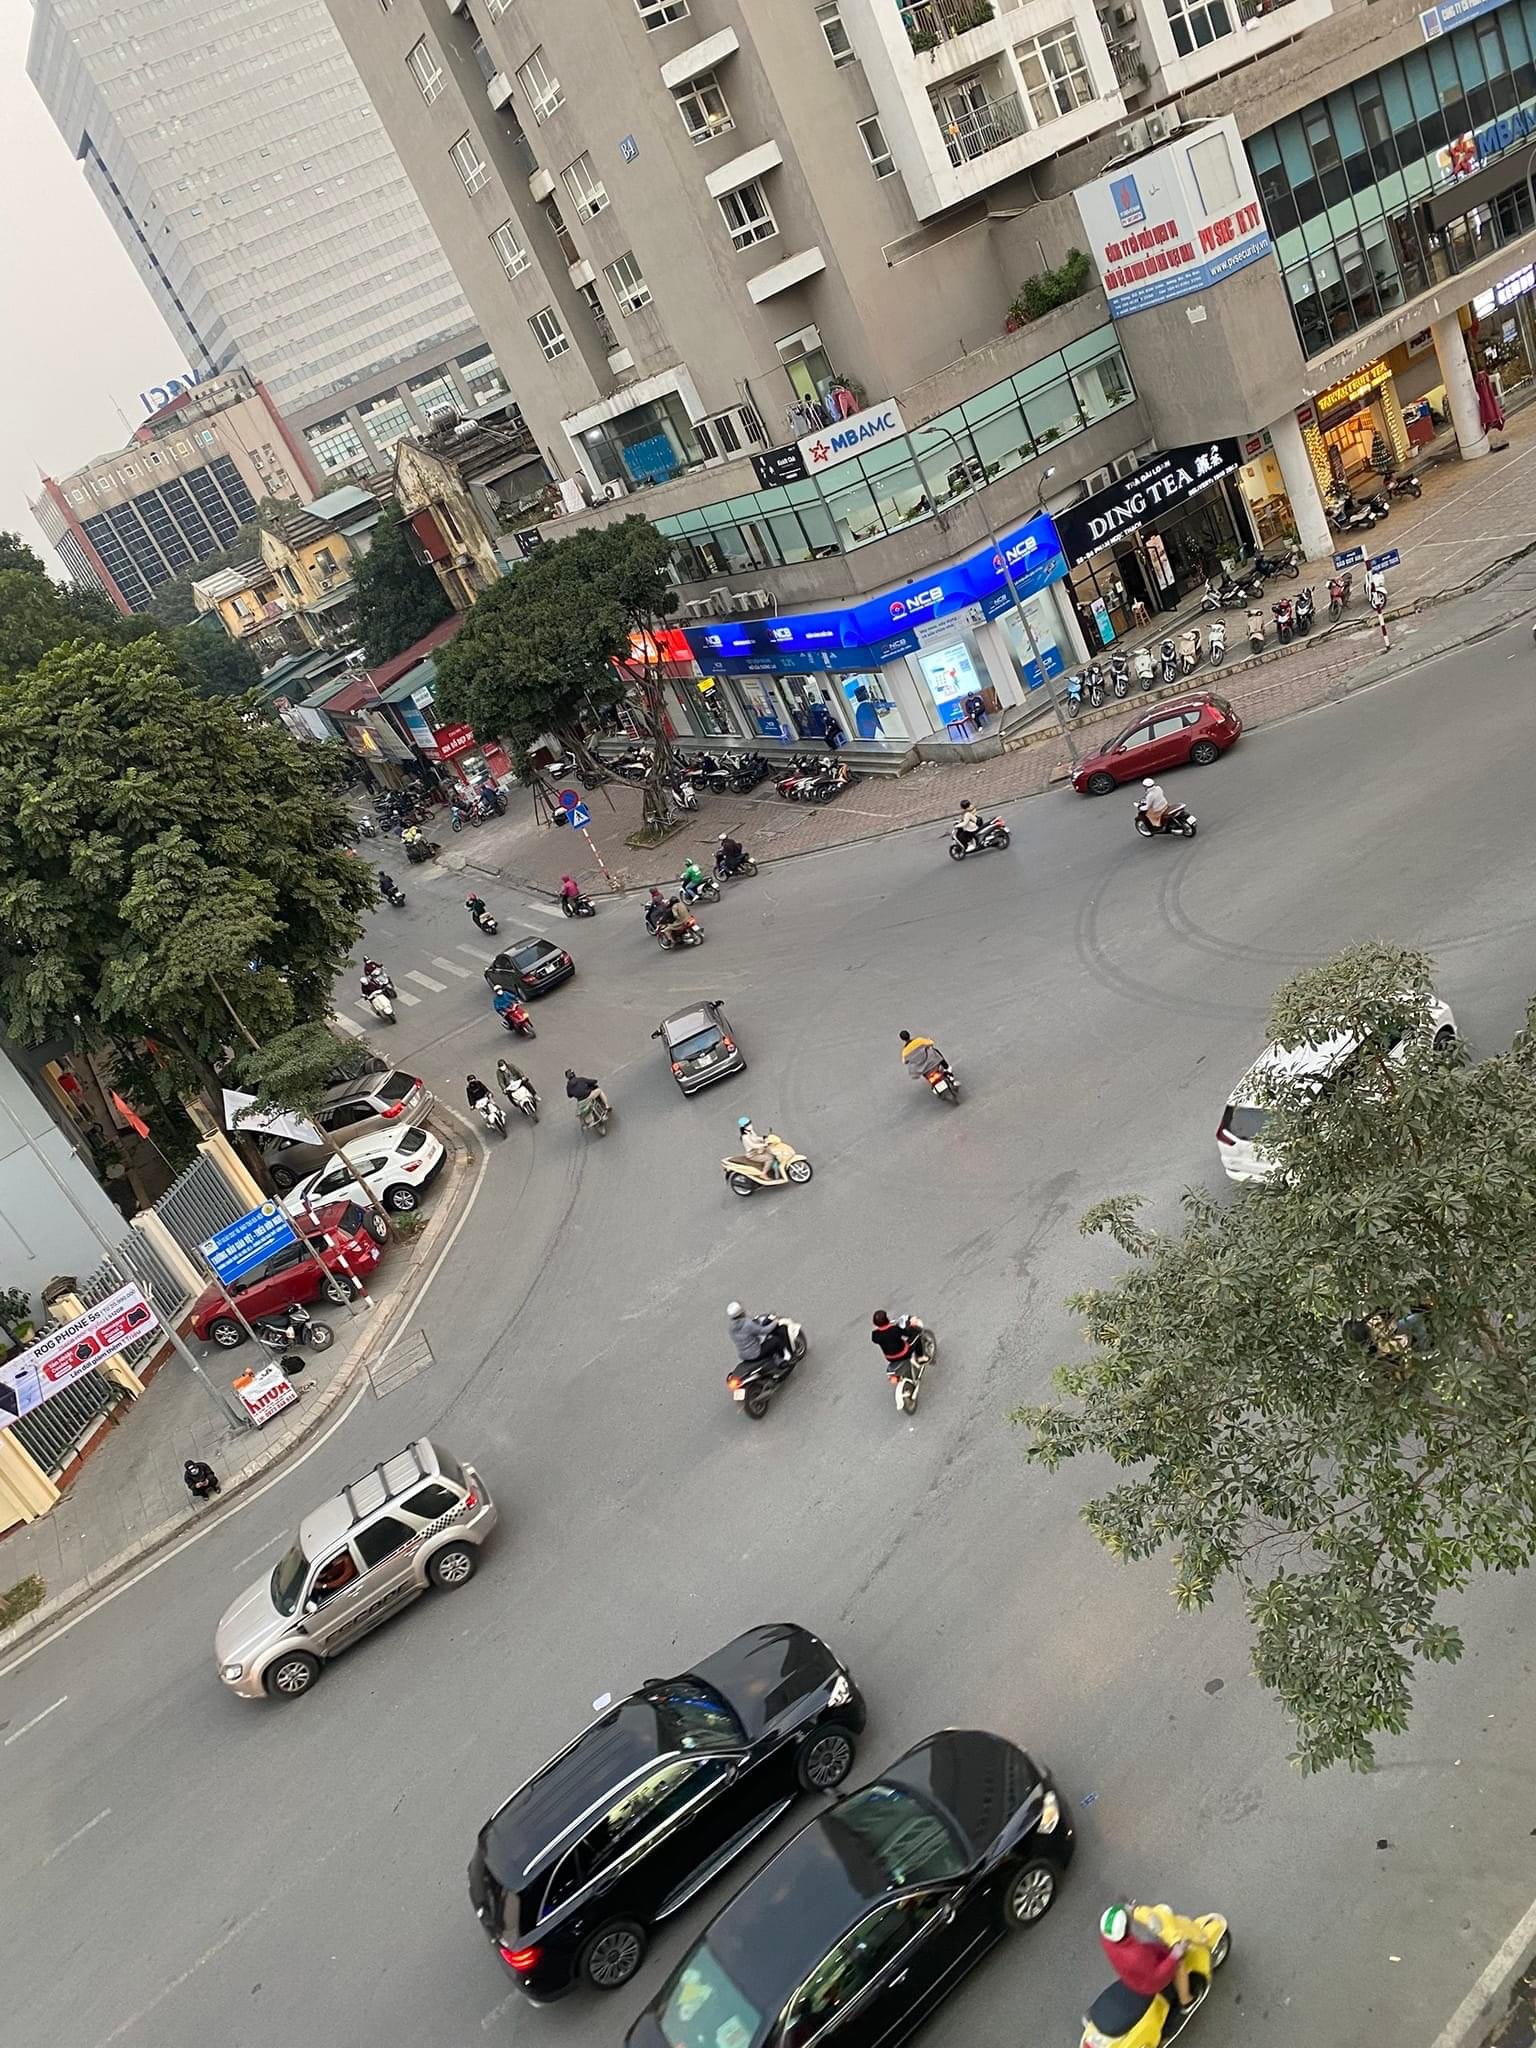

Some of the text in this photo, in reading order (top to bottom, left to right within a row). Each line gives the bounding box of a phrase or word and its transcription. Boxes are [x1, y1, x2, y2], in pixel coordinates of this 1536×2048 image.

[622, 139, 636, 160] B4
[831, 412, 895, 452] MBAMC
[1086, 466, 1194, 540] DING TEA
[1005, 536, 1037, 562] NCB
[906, 586, 944, 610] NCB
[33, 1338, 55, 1357] ROG
[55, 1318, 88, 1343] PHONE
